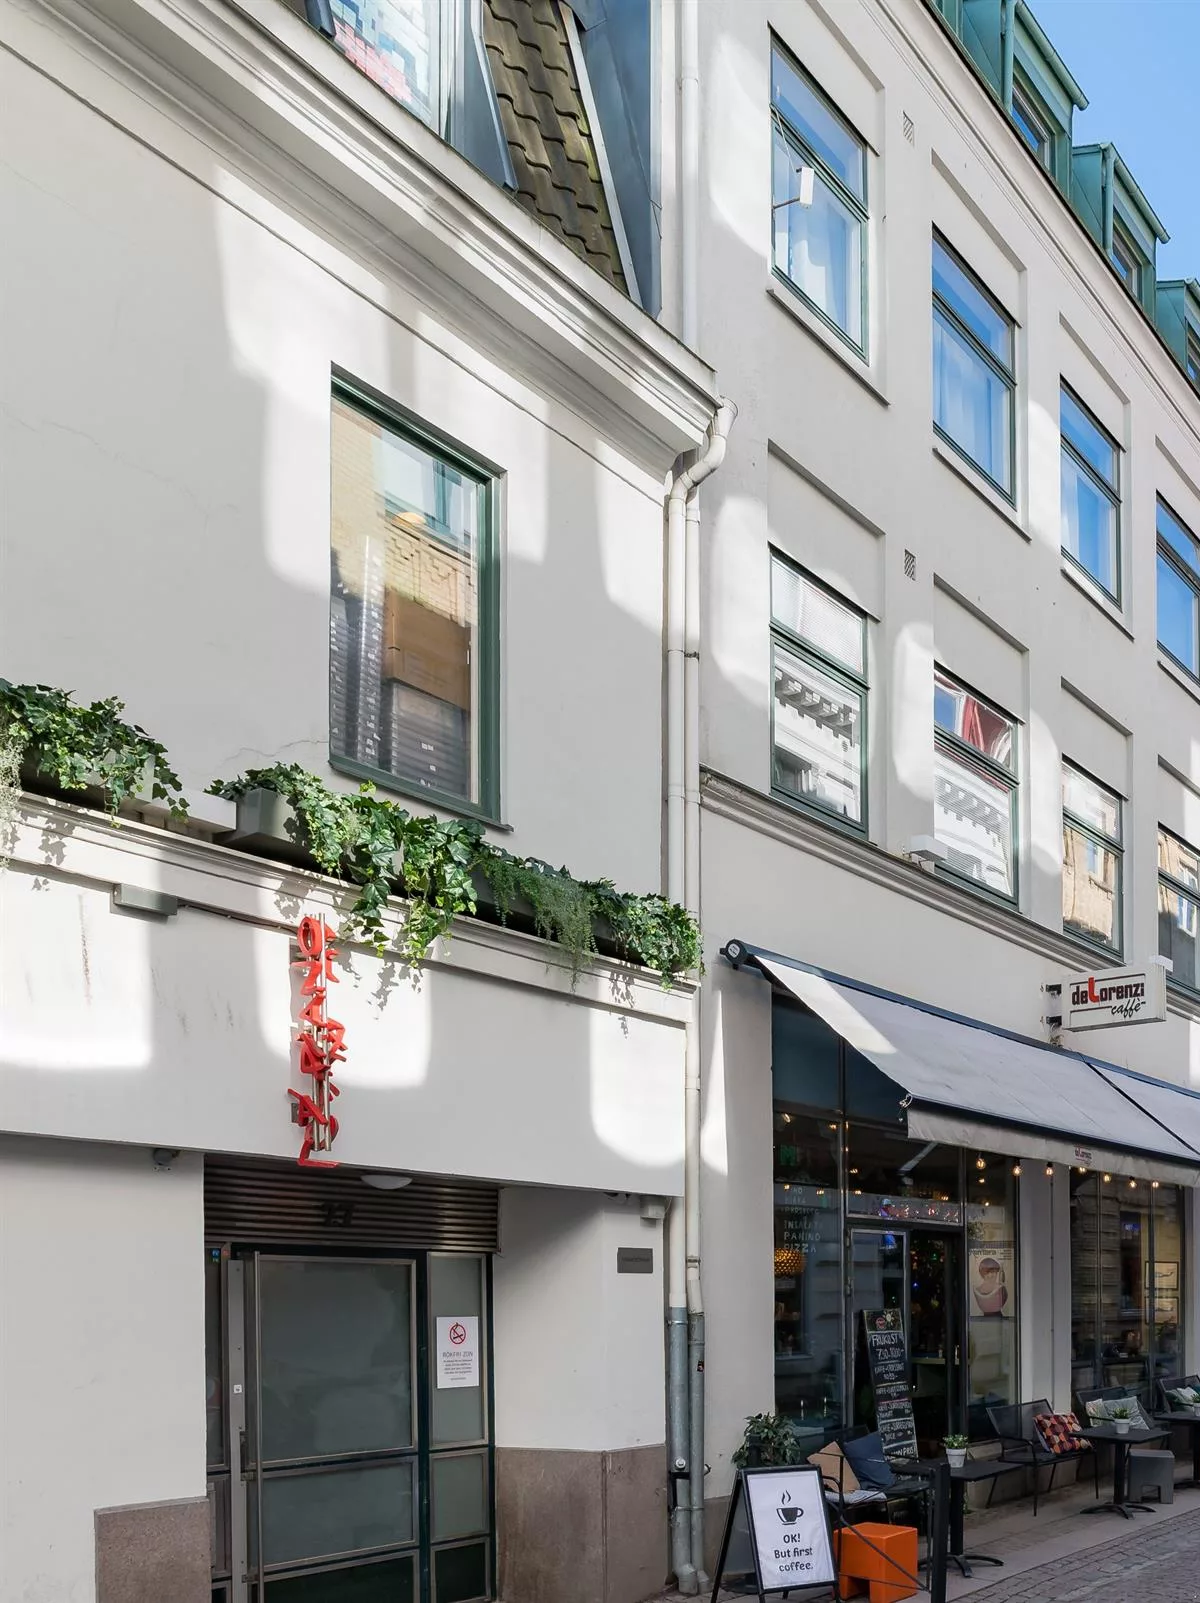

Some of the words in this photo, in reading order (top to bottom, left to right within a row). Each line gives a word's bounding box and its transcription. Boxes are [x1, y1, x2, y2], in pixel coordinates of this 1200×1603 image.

[1071, 976, 1145, 1005] deLorenzi
[1111, 998, 1141, 1019] caffè
[783, 1533, 801, 1544] OK!
[774, 1548, 791, 1559] But
[793, 1547, 813, 1558] first
[778, 1561, 814, 1572] coffee.
